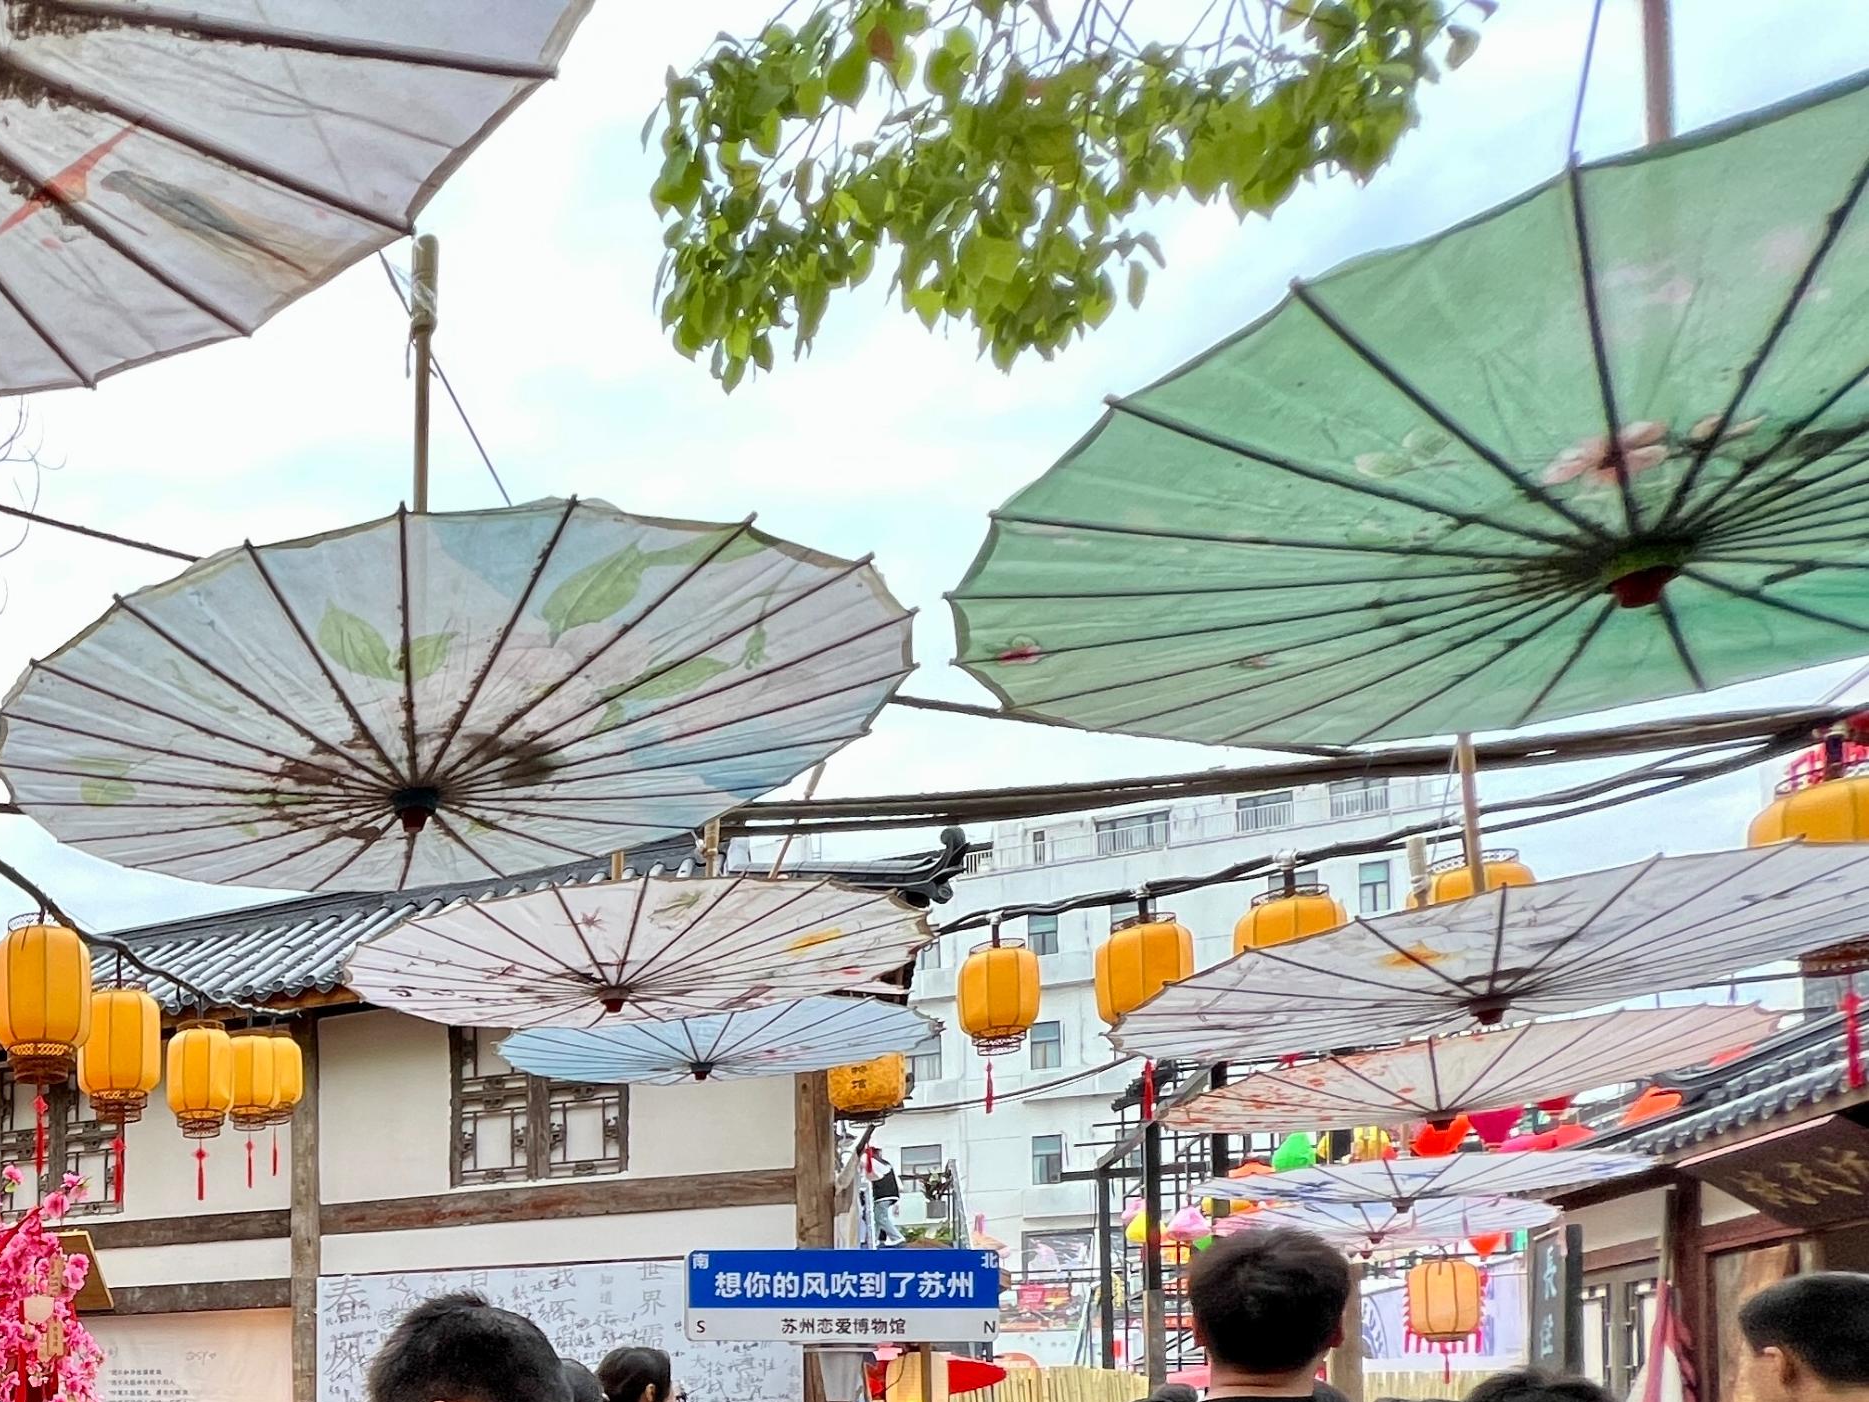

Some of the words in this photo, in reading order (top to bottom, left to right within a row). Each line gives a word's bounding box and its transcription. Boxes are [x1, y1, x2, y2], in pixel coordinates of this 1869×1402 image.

[692, 1253, 710, 1269] 南
[981, 1252, 998, 1269] 北
[714, 1271, 975, 1299] 想你的风吹到了苏州
[696, 1320, 706, 1333] S
[781, 1317, 906, 1335] 苏州恋爱博物馆
[984, 1320, 996, 1333] N
